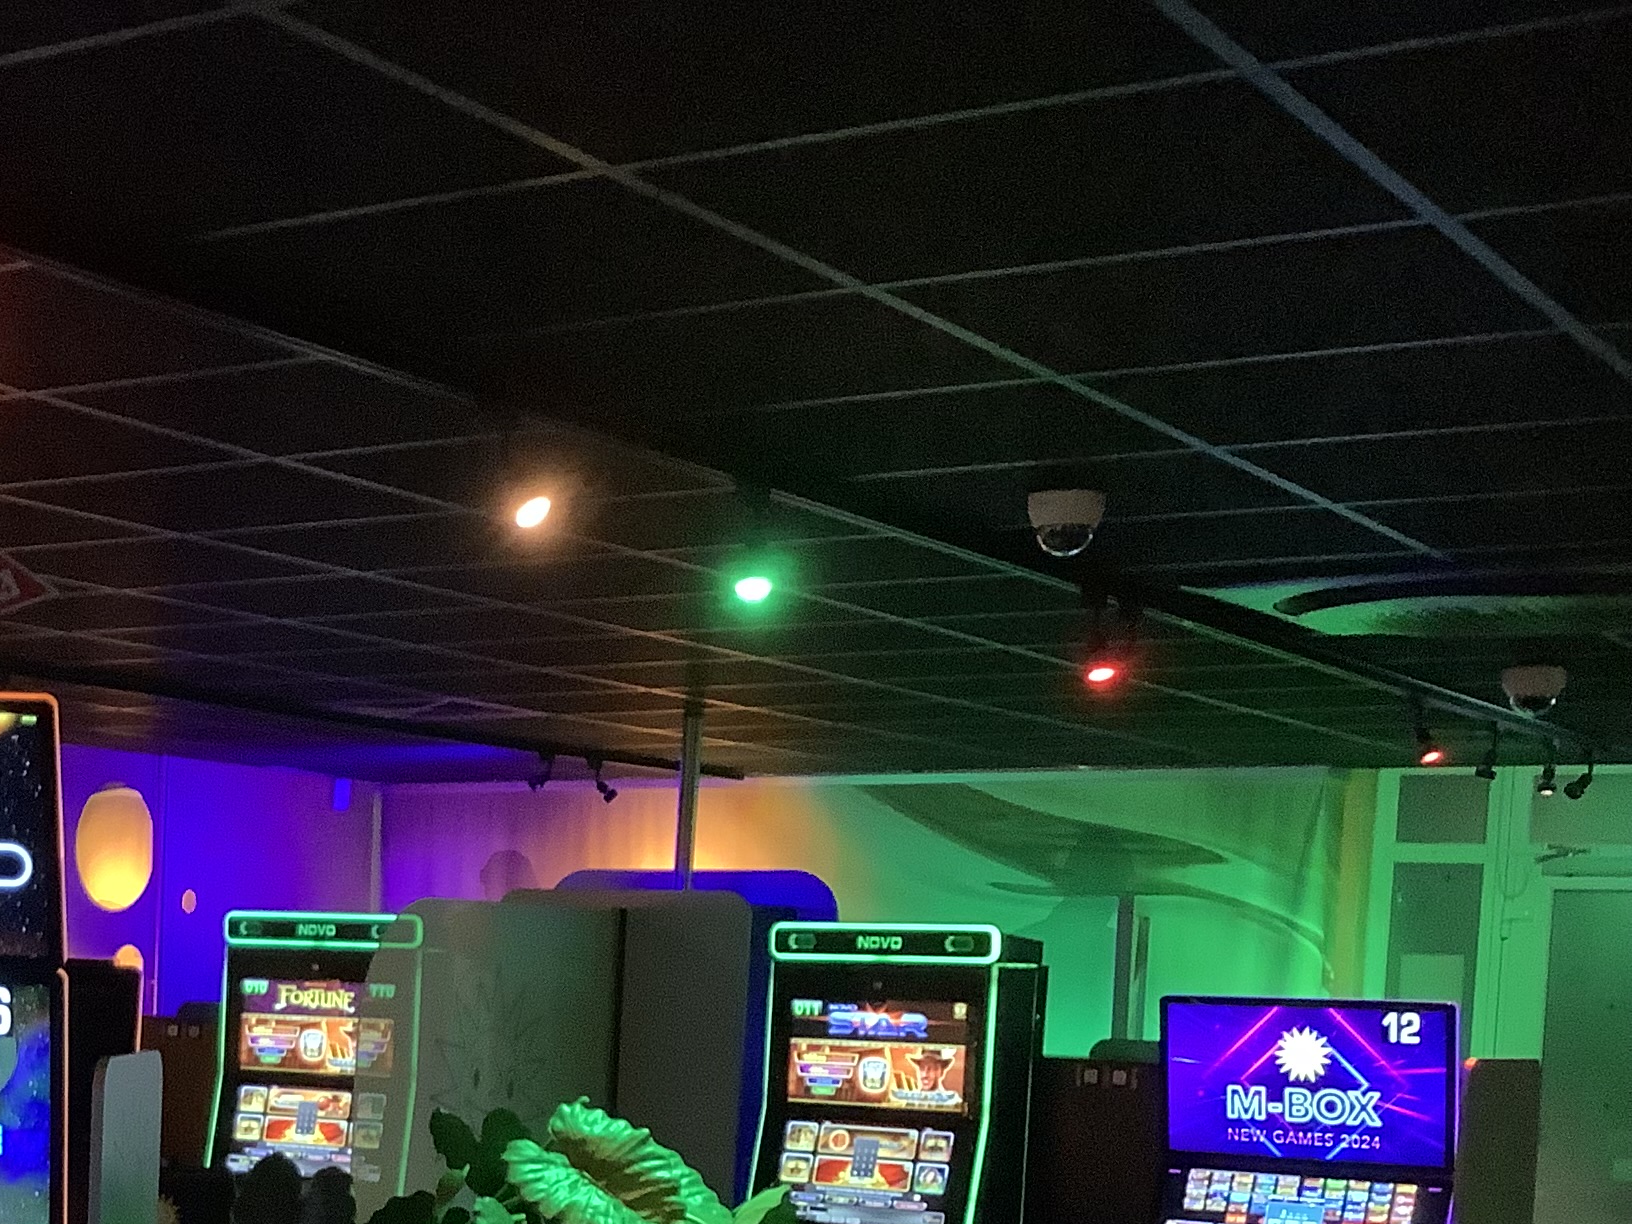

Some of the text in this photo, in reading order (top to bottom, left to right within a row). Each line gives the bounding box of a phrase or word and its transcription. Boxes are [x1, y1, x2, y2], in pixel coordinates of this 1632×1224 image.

[296, 923, 336, 937] NOVO
[856, 935, 903, 950] NOVO
[274, 984, 356, 1013] FORTUNE
[1381, 1012, 1421, 1044] 12
[1226, 1084, 1383, 1128] M-BOX
[1227, 1127, 1381, 1150] NEW GAMES 2024
